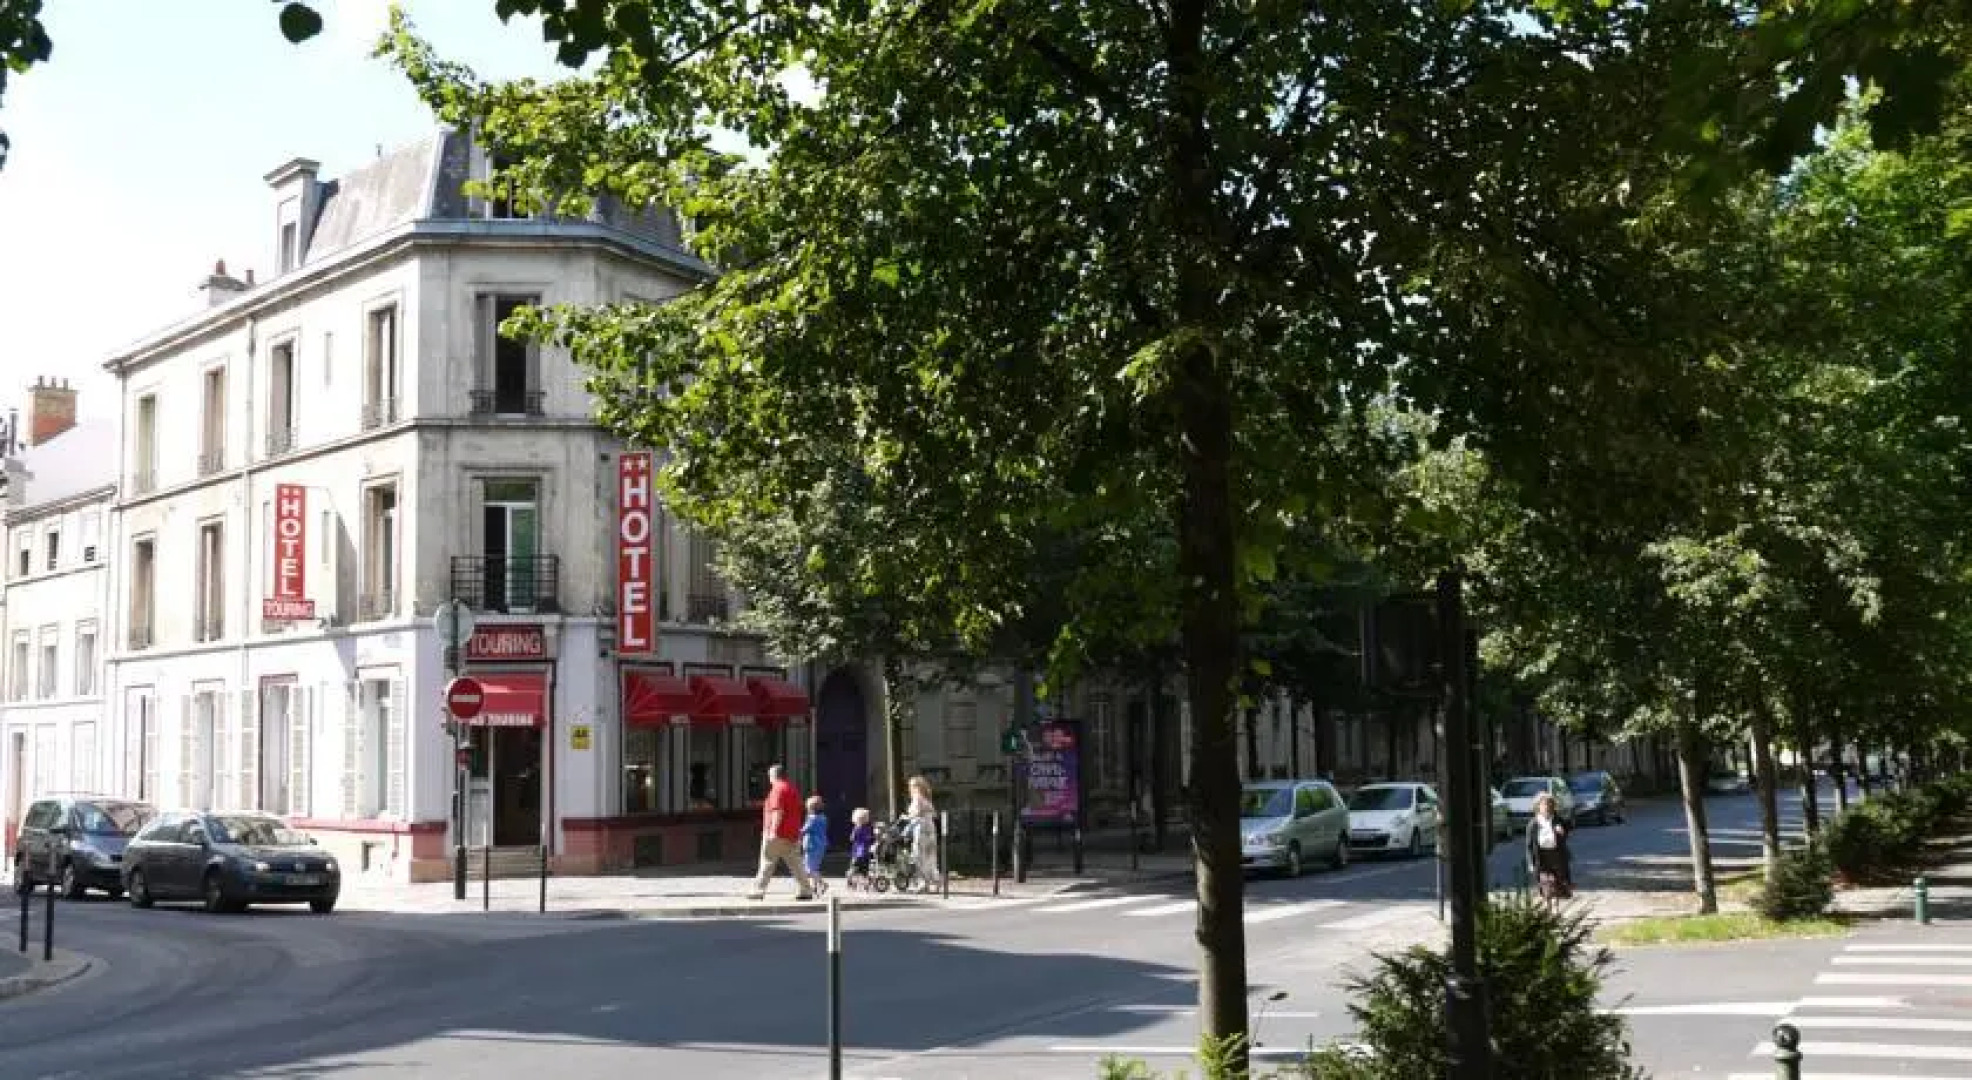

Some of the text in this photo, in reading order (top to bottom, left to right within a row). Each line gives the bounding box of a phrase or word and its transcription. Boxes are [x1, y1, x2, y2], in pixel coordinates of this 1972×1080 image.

[280, 499, 301, 595] HOTEL
[621, 476, 649, 647] HOTEL
[265, 601, 313, 616] TOURING
[470, 632, 541, 654] TOURING
